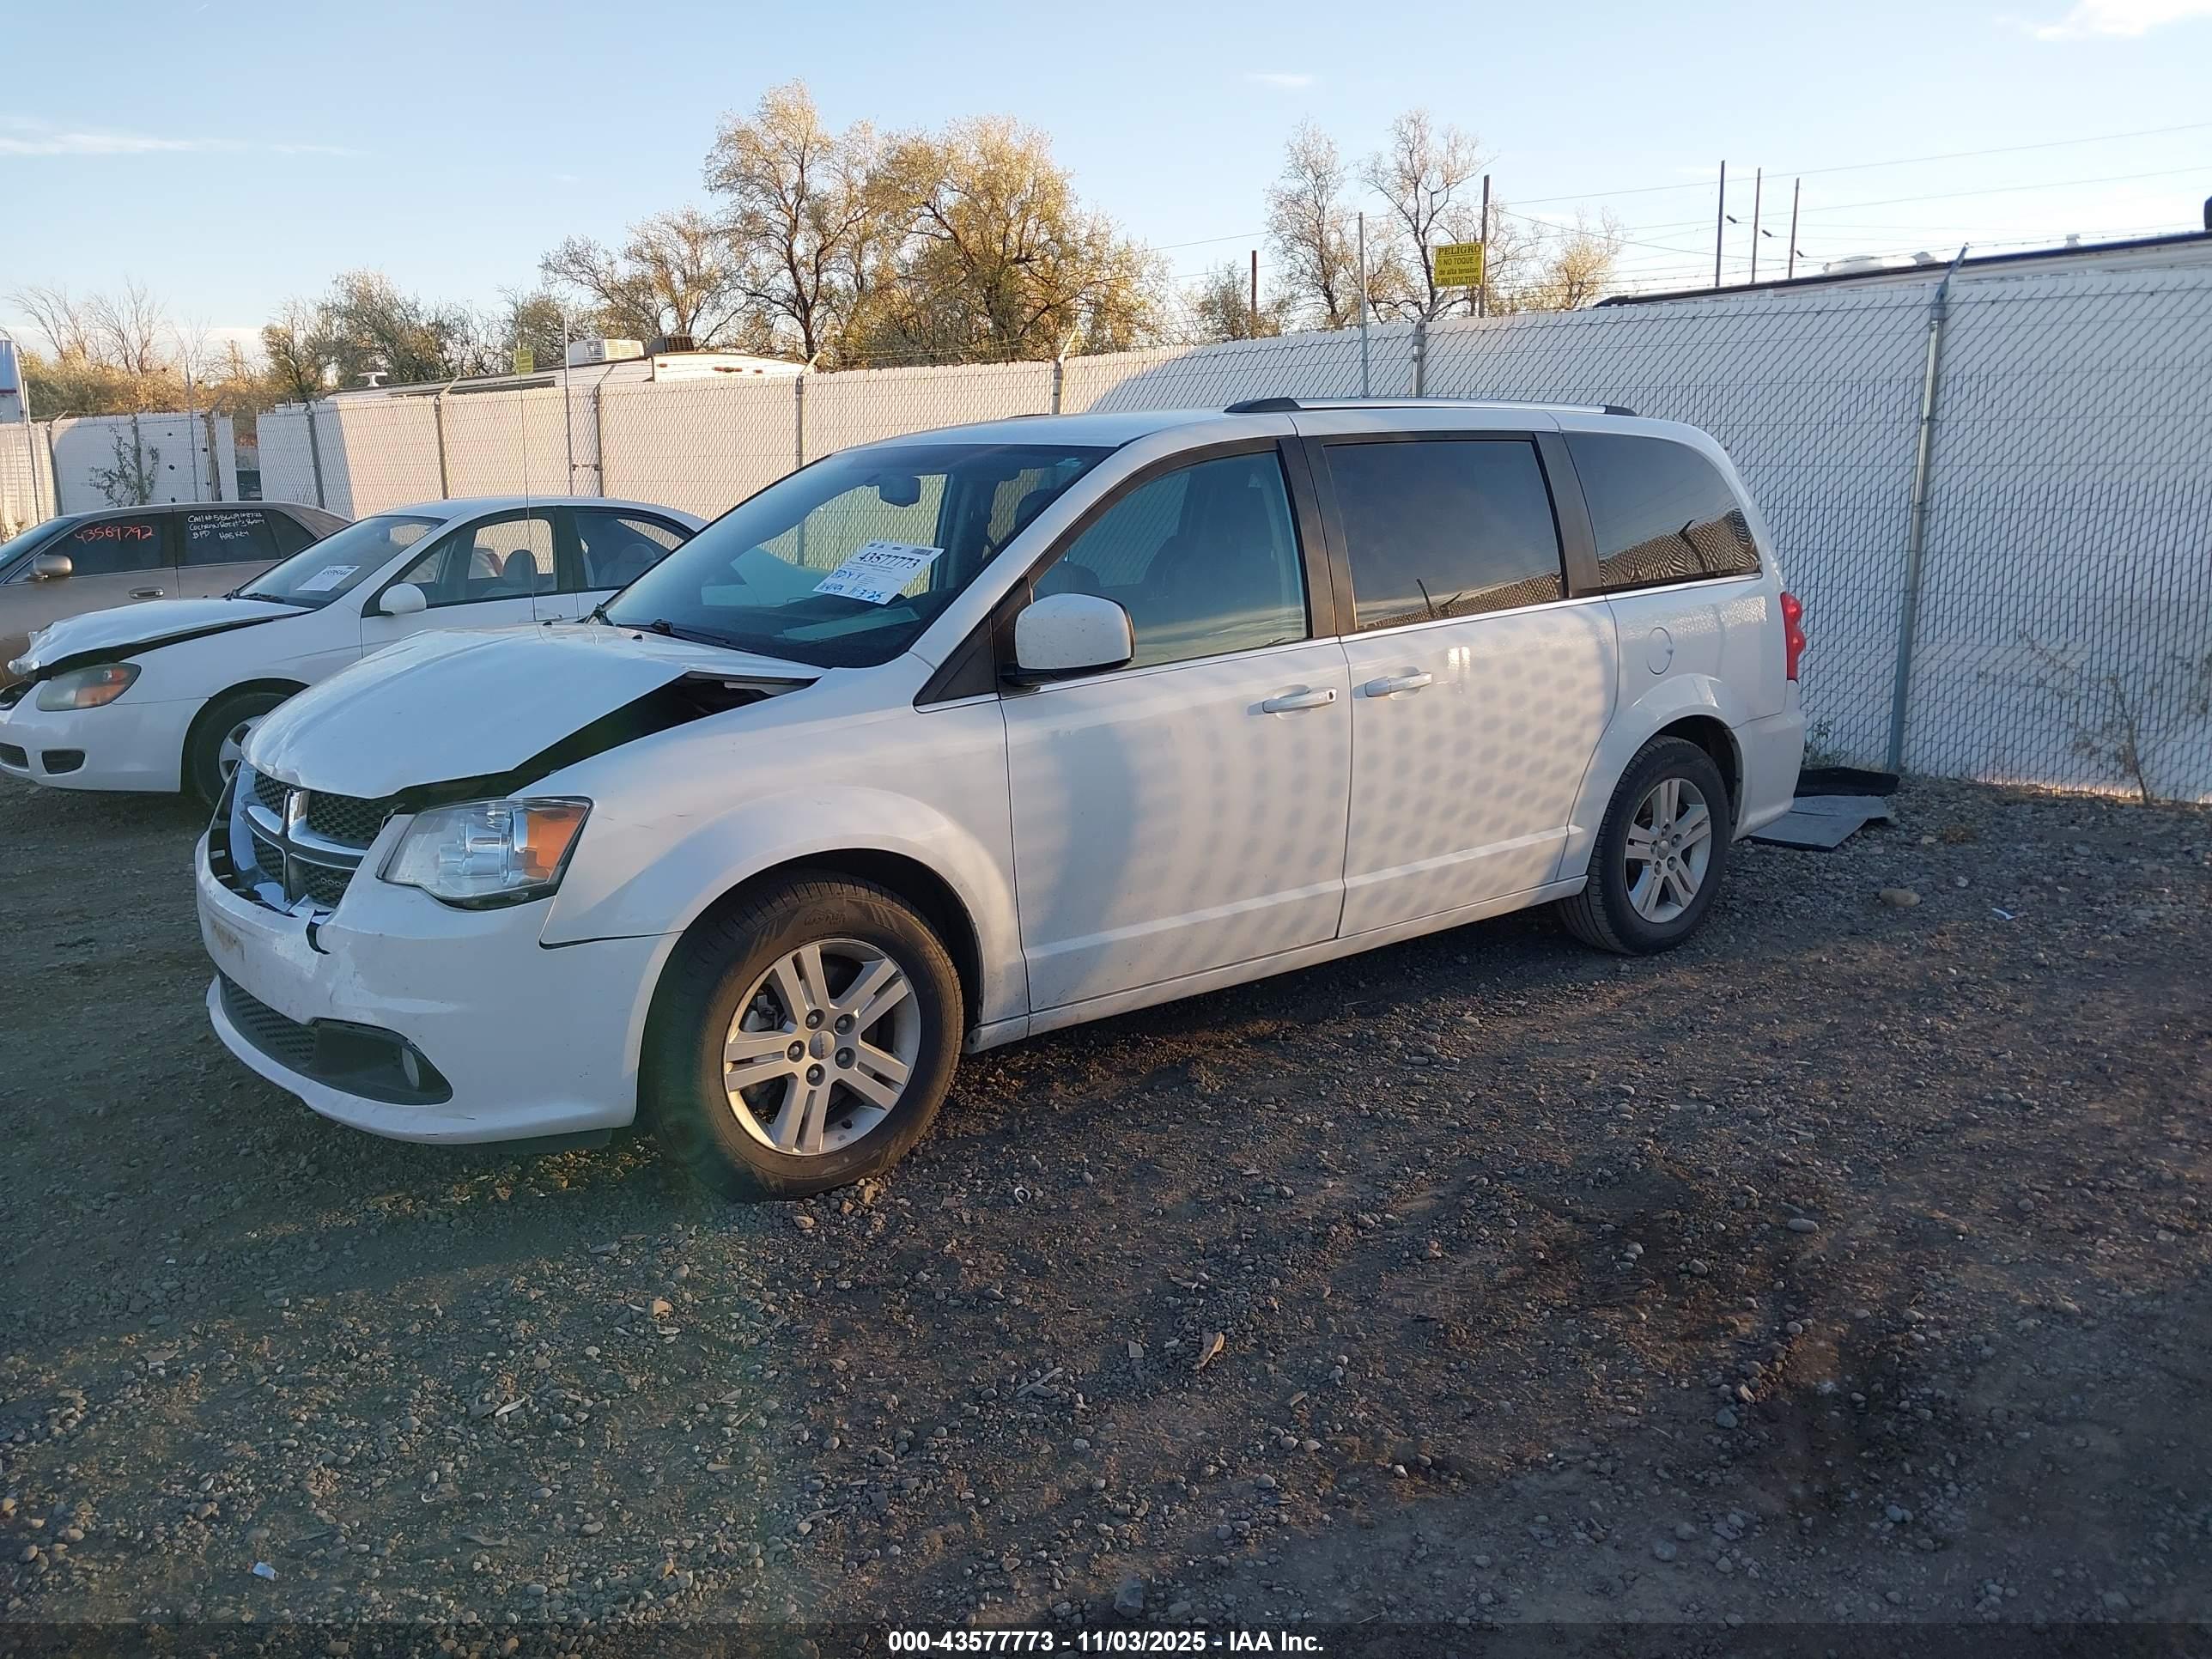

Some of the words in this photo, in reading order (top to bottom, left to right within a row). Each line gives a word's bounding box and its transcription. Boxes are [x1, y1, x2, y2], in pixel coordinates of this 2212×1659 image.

[1438, 245, 1481, 256] PELIGRO
[1454, 257, 1474, 265] TOQUE
[1452, 276, 1480, 285] VOLTIOS
[75, 526, 155, 544] 43569792
[859, 551, 921, 568] 43577773
